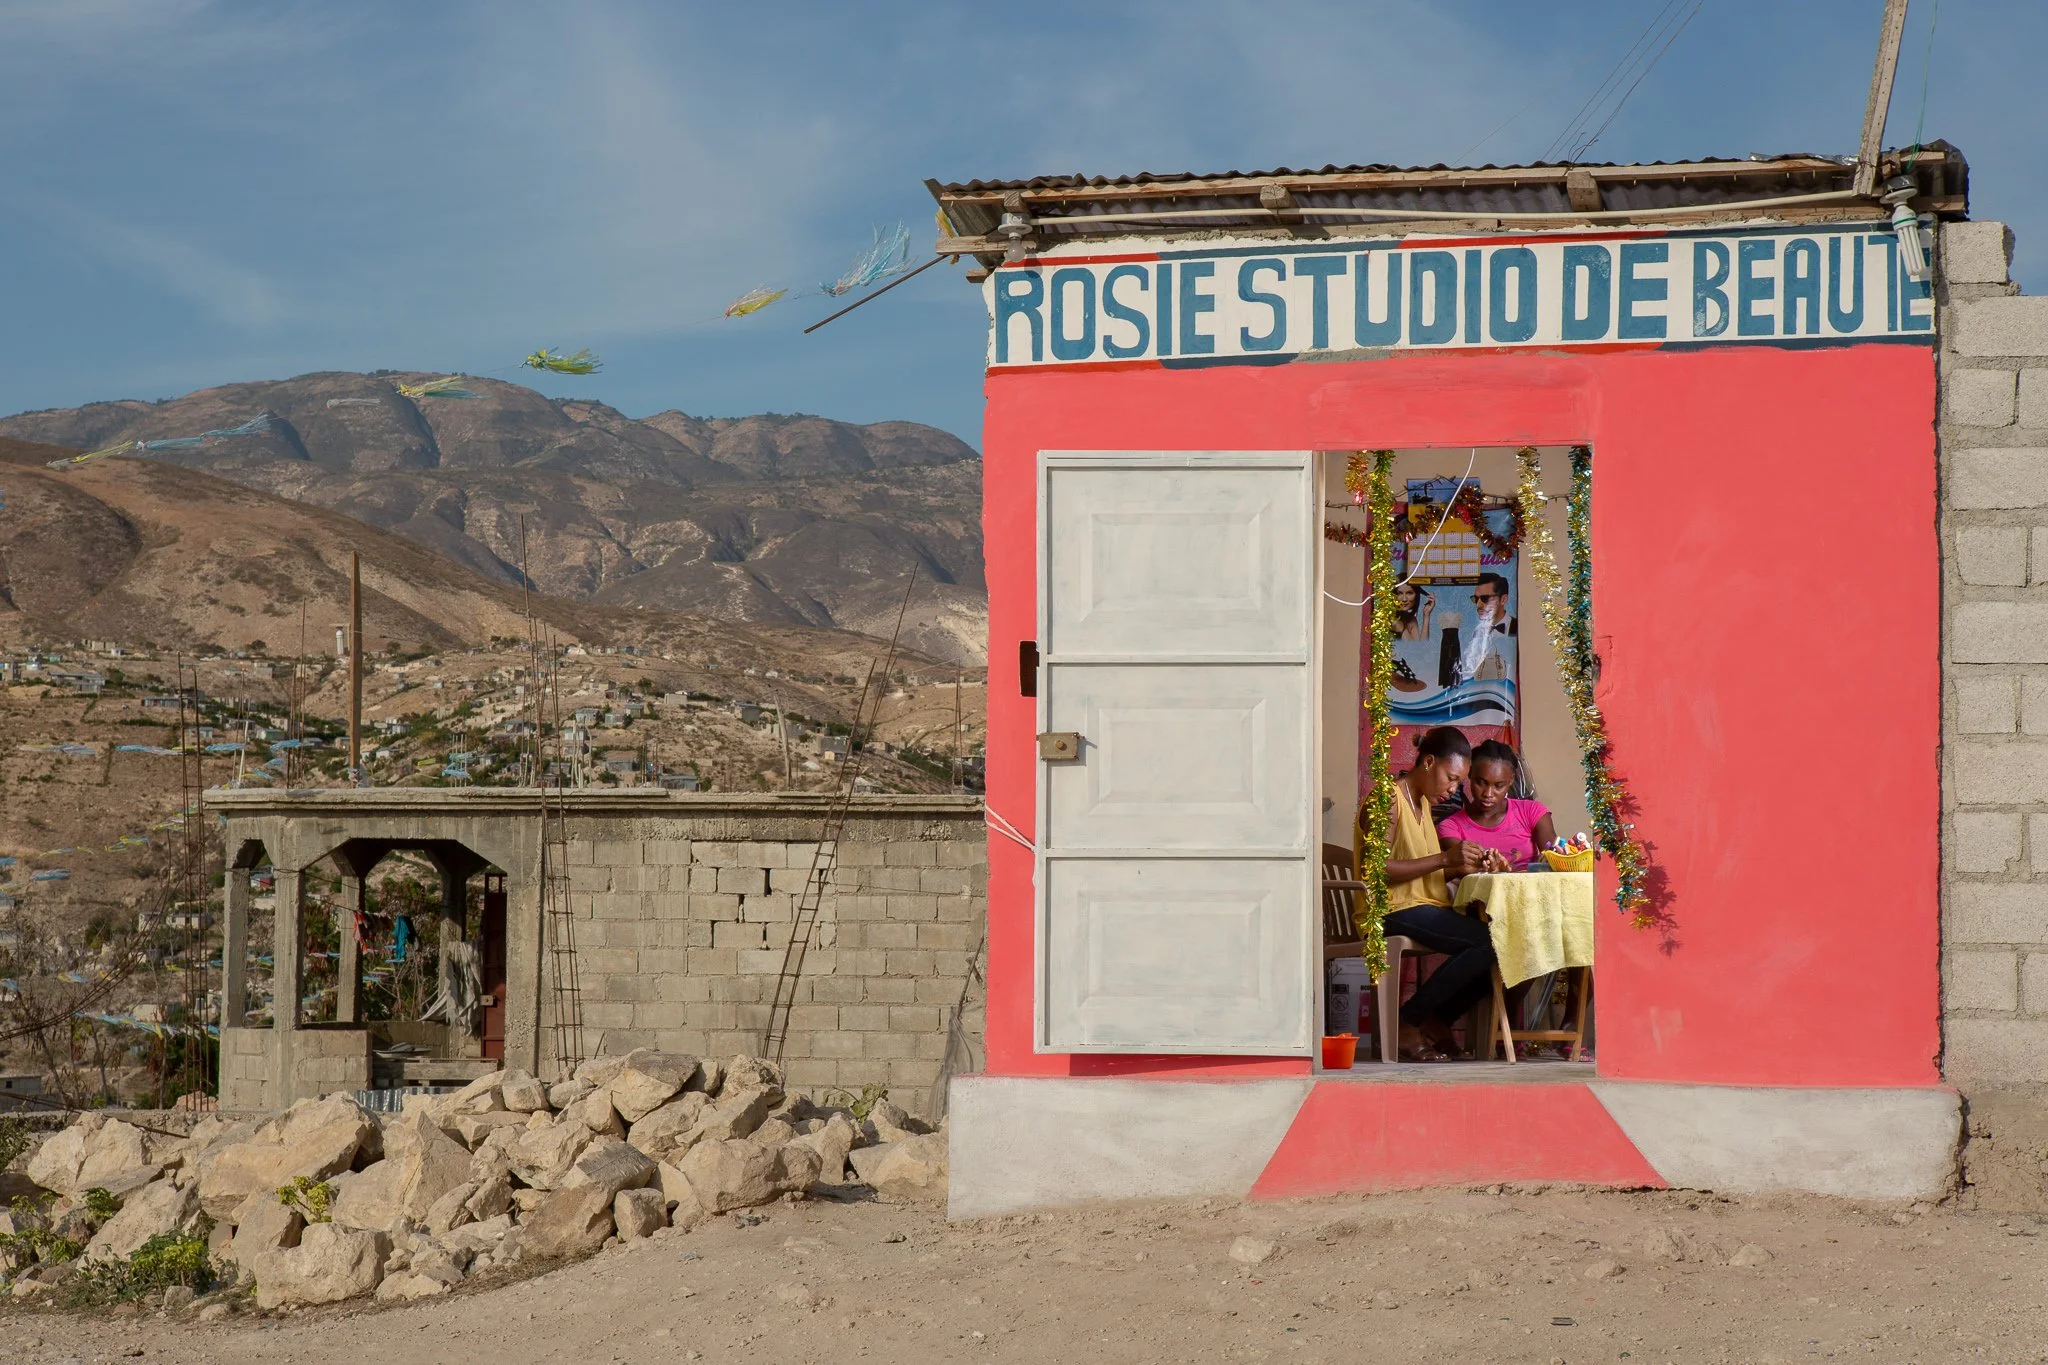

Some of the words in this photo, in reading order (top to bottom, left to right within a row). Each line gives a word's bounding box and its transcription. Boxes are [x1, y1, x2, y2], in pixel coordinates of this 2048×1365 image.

[994, 261, 1215, 363] ROSIE
[1239, 247, 1537, 351] STUDIO
[1562, 242, 1669, 341] DE
